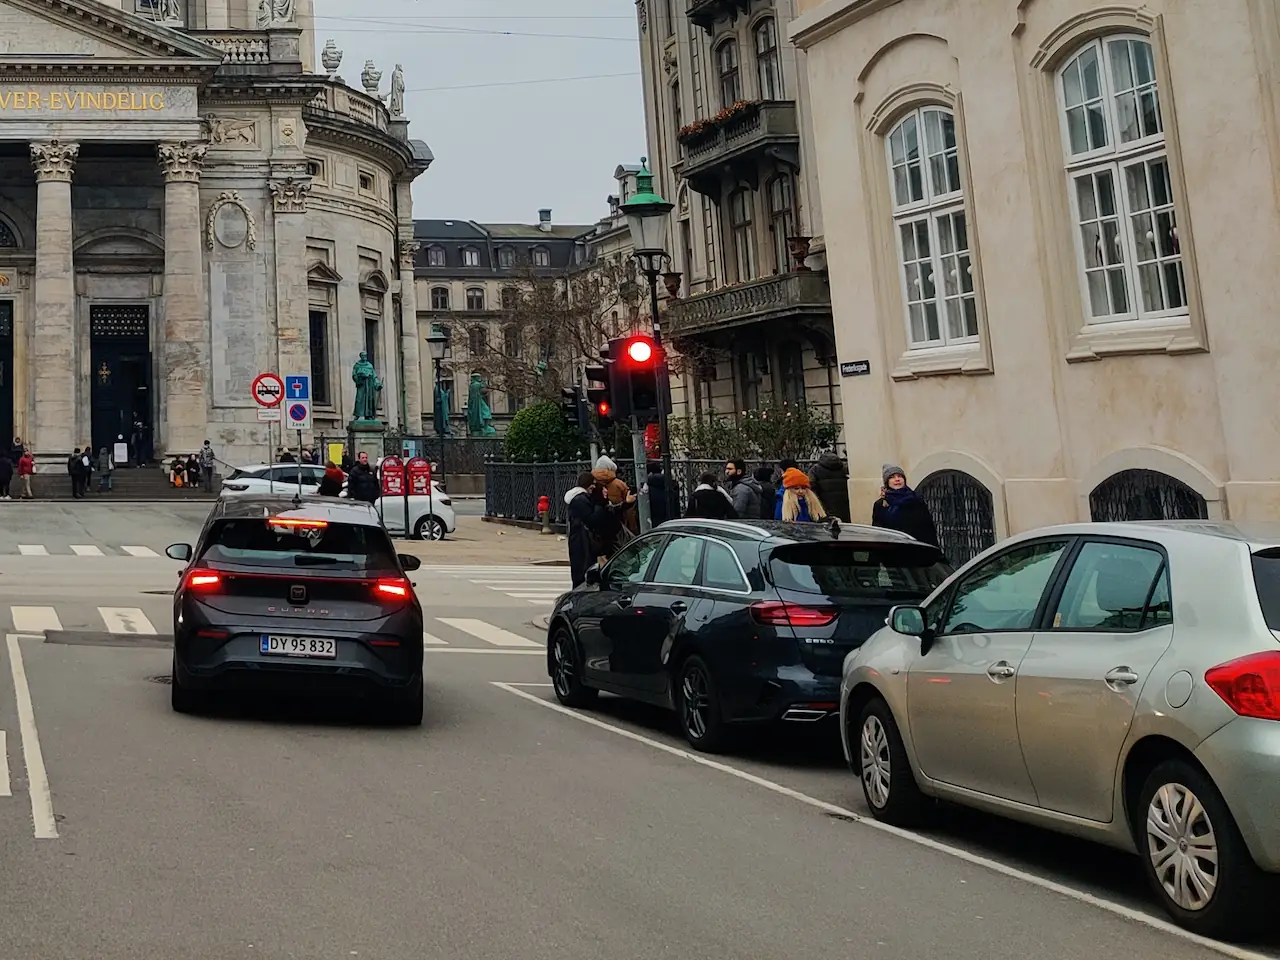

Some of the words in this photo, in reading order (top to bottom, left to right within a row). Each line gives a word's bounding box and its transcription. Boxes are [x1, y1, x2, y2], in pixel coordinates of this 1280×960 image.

[49, 91, 165, 111] EVINDELIG
[267, 606, 329, 614] CUPRA
[270, 637, 287, 650] DY
[291, 639, 306, 651] 95
[309, 640, 333, 654] 832
